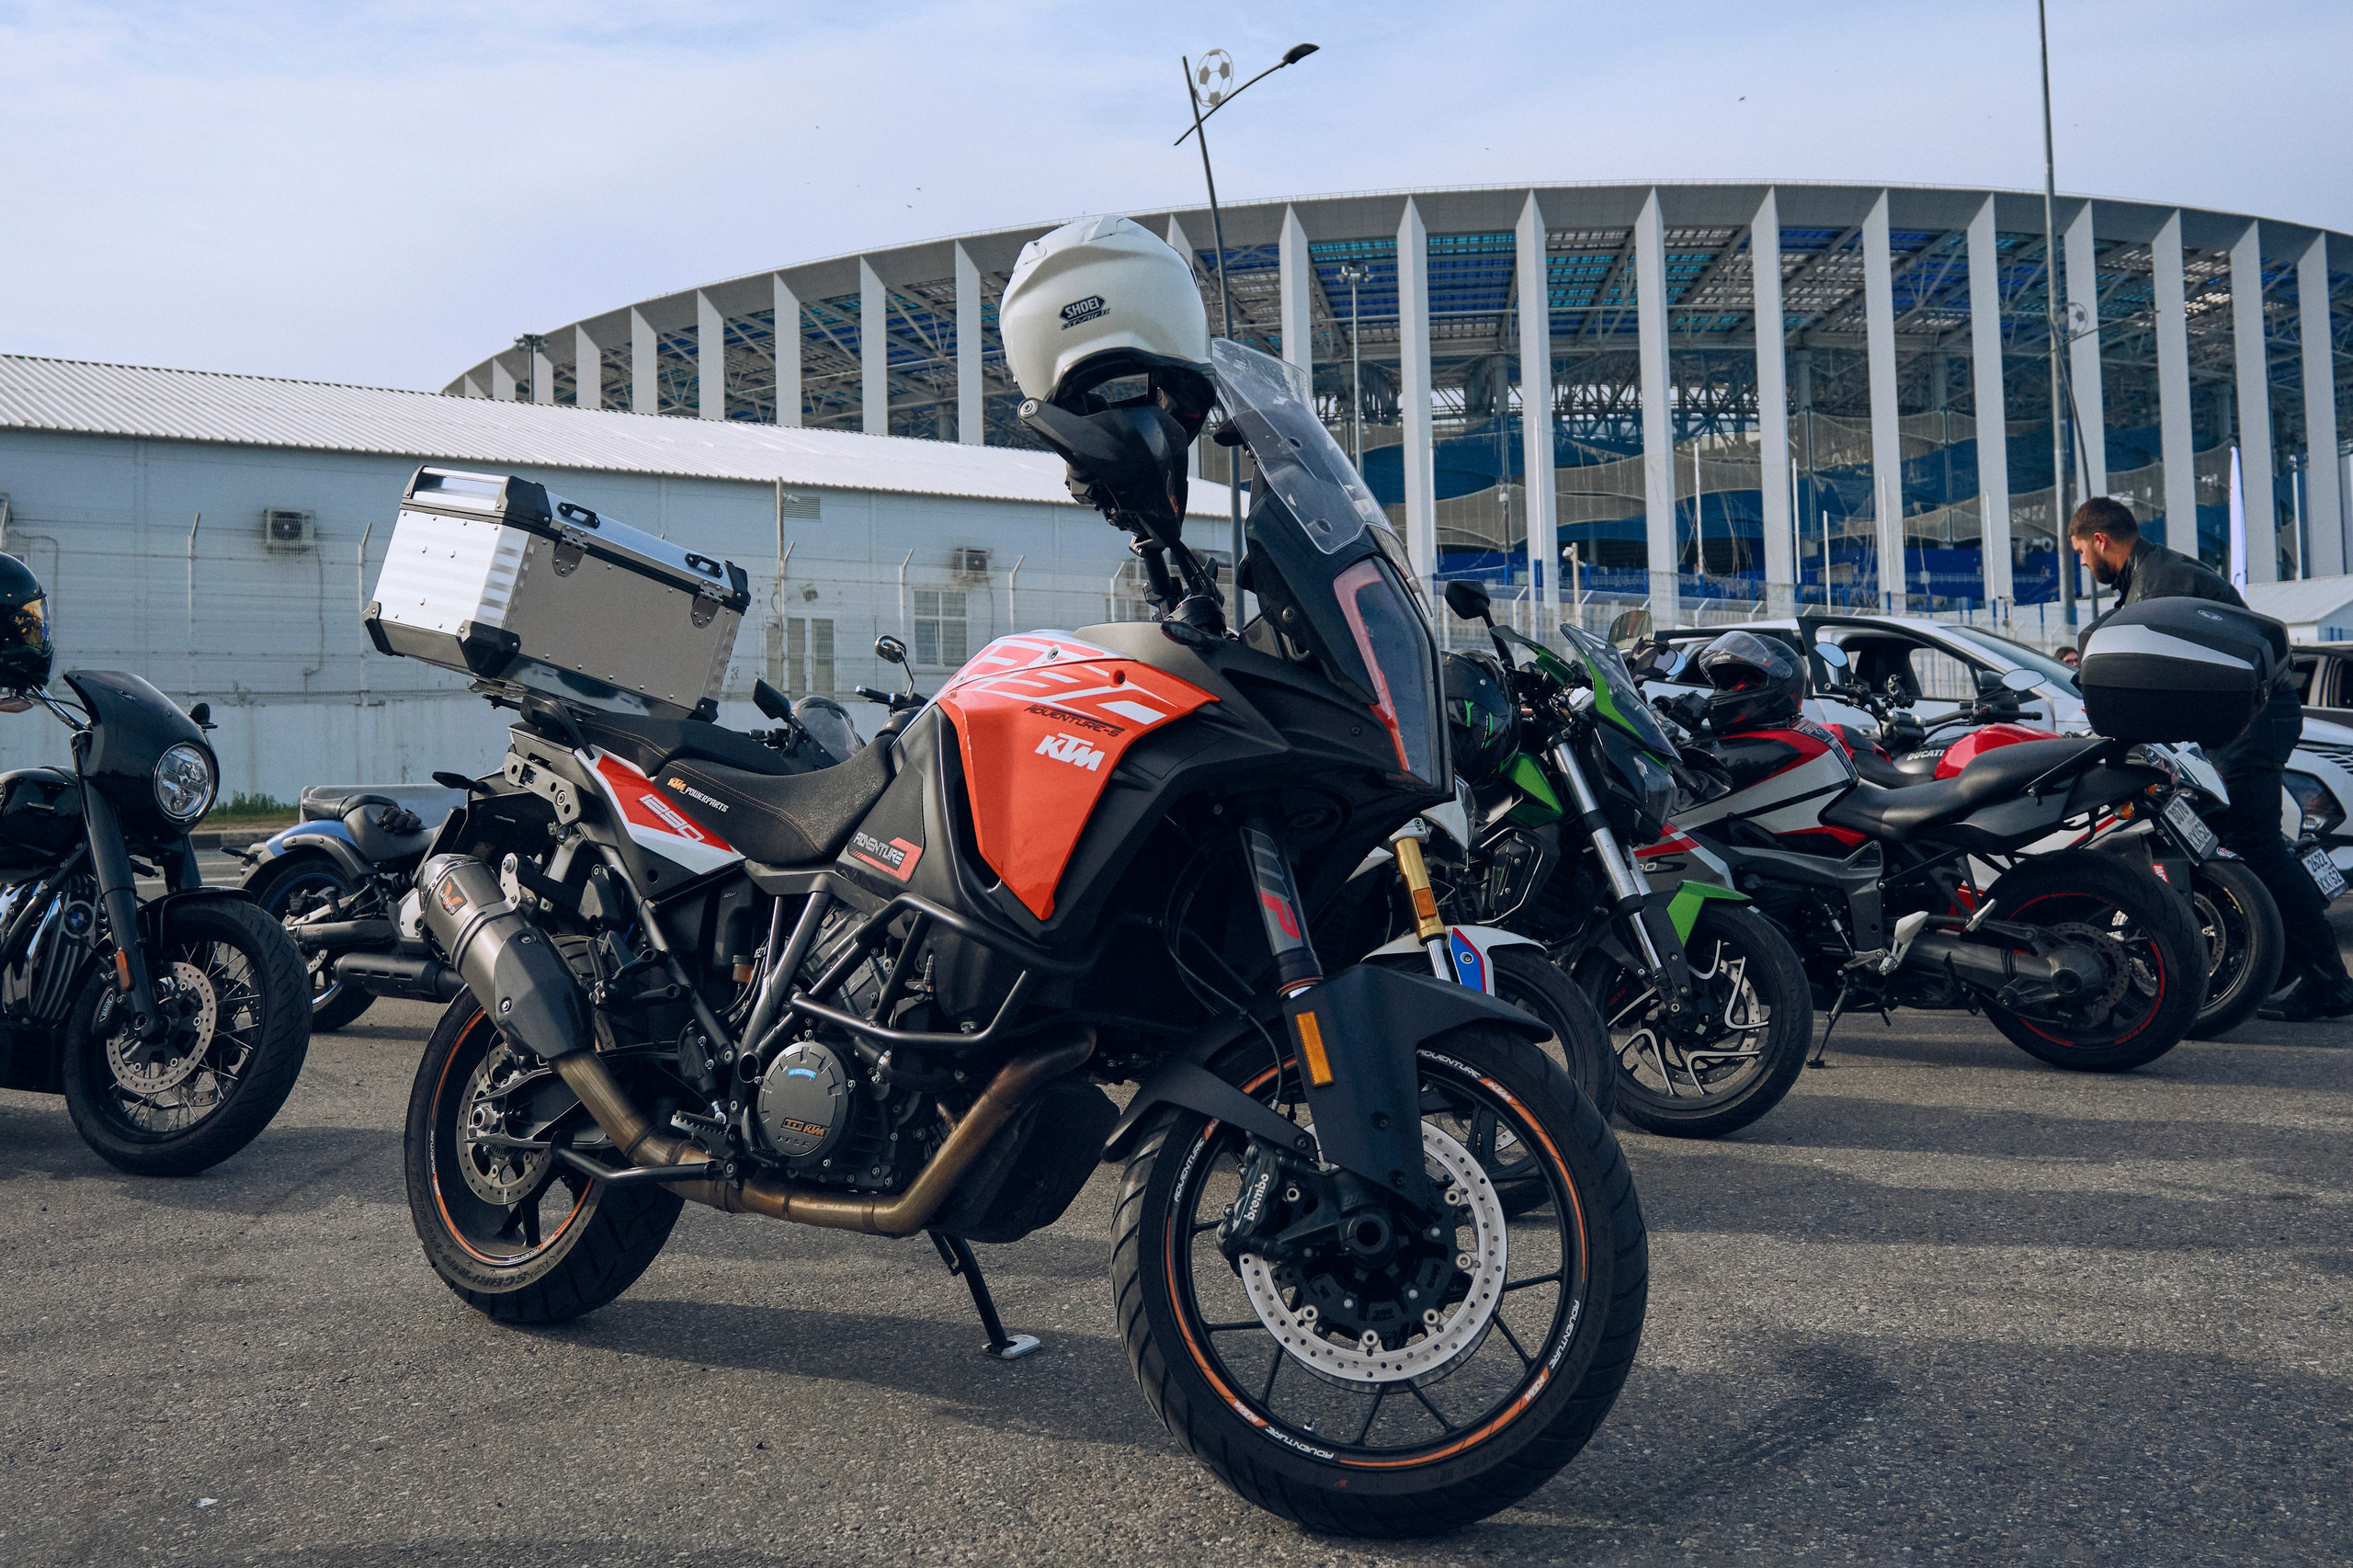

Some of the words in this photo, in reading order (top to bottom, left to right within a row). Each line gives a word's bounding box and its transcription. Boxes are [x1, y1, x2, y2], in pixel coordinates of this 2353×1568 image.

[1064, 297, 1099, 319] SHOEI
[1024, 706, 1123, 737] ADVENTURE-S
[1035, 733, 1106, 771] KTM
[1906, 749, 1946, 761] DUCATI
[667, 777, 688, 791] KTM
[853, 831, 905, 866] ADVENTURE
[2307, 852, 2328, 872] 2622
[2317, 874, 2334, 892] XX
[2329, 869, 2343, 884] 52
[1416, 1049, 1482, 1078] ADVENTURE
[1487, 1081, 1513, 1102] KTM
[803, 1124, 825, 1137] KTM
[1174, 1137, 1205, 1202] ADVENTURE
[1244, 1172, 1269, 1221] brembo
[1549, 1299, 1580, 1370] ADVENTURE
[1525, 1374, 1546, 1402] KTM
[1233, 1401, 1259, 1423] KTM
[1265, 1426, 1335, 1460] ADVENTURE
